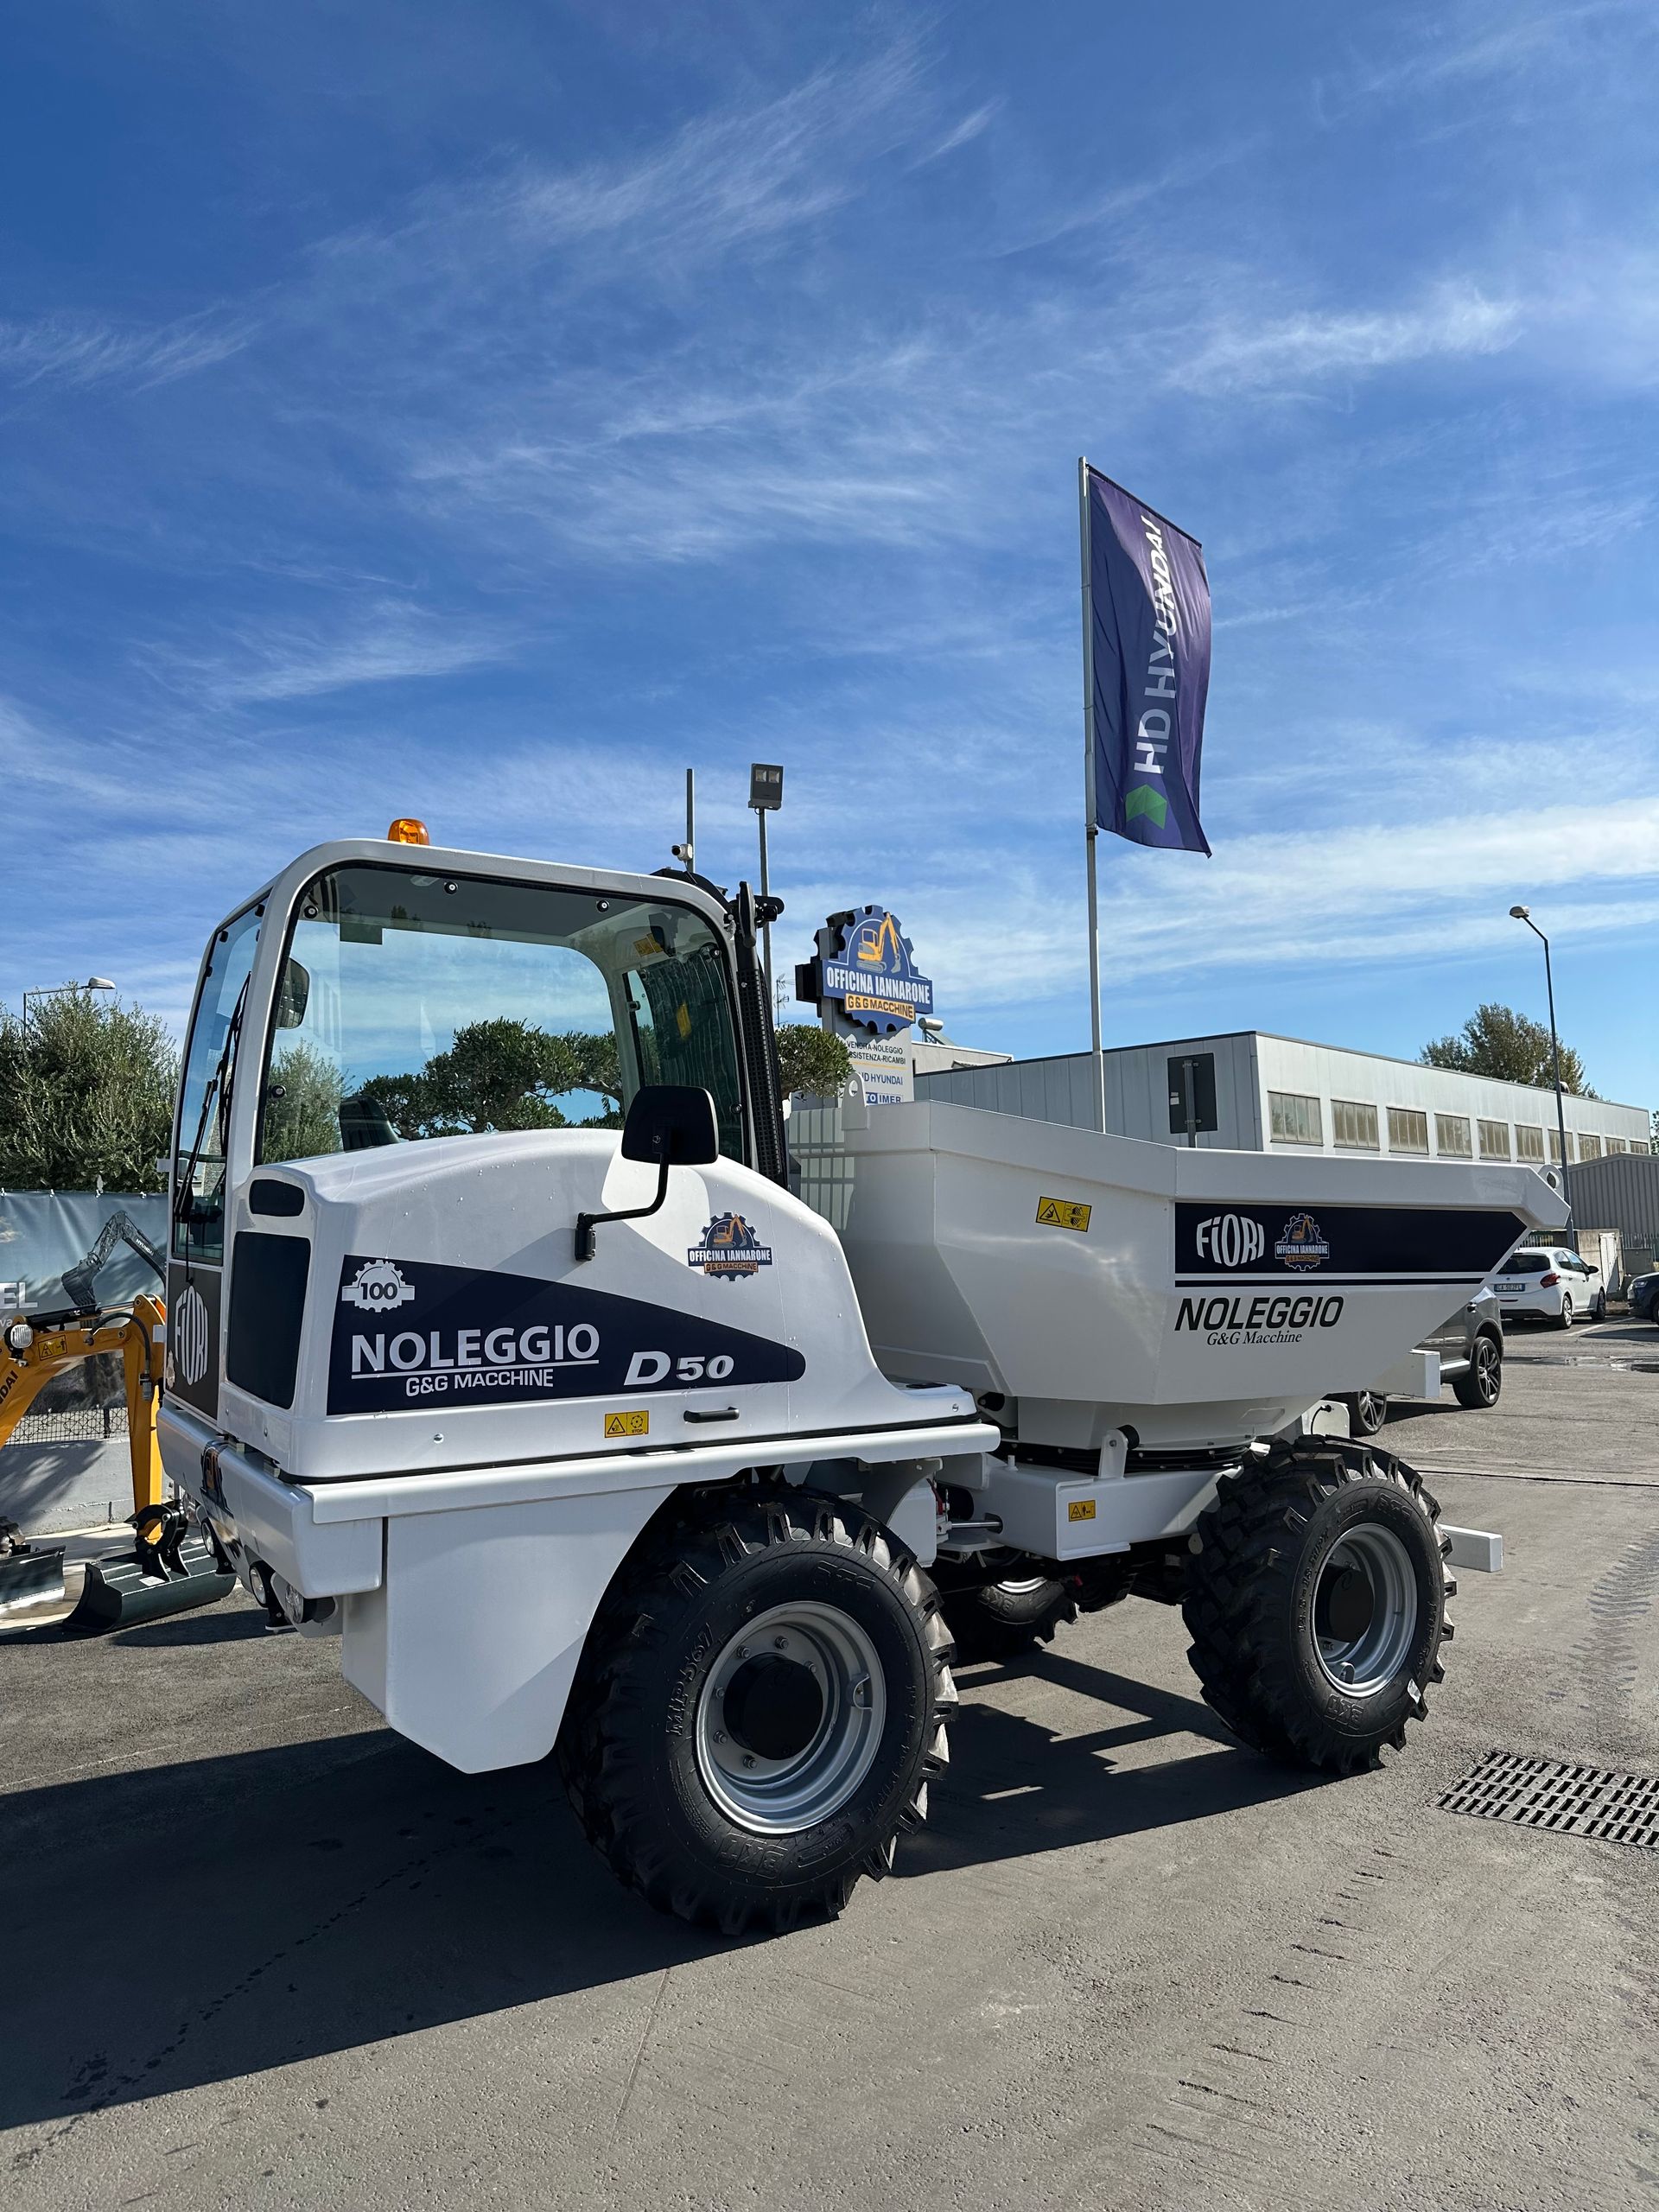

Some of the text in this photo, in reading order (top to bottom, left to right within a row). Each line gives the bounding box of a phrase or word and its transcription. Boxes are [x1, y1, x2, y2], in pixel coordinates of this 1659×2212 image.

[1134, 515, 1177, 774] HD HYUNDAI
[827, 966, 931, 1005] OFFICINA IANNARONE
[848, 995, 854, 1008] G
[862, 998, 868, 1008] G
[869, 999, 913, 1019] MACCHINE
[870, 1073, 904, 1085] HYUNDAI
[690, 1249, 771, 1262] OFFICINA IANNARONE
[1276, 1244, 1328, 1255] OFFICINA IANNARONE
[360, 1282, 397, 1300] 100
[1174, 1296, 1344, 1332] NOLEGGIO
[352, 1323, 600, 1373] NOLEGGIO
[1206, 1330, 1302, 1345] G&G Macchine
[623, 1351, 734, 1386] D 50
[405, 1369, 554, 1397] G&G MACCHINE
